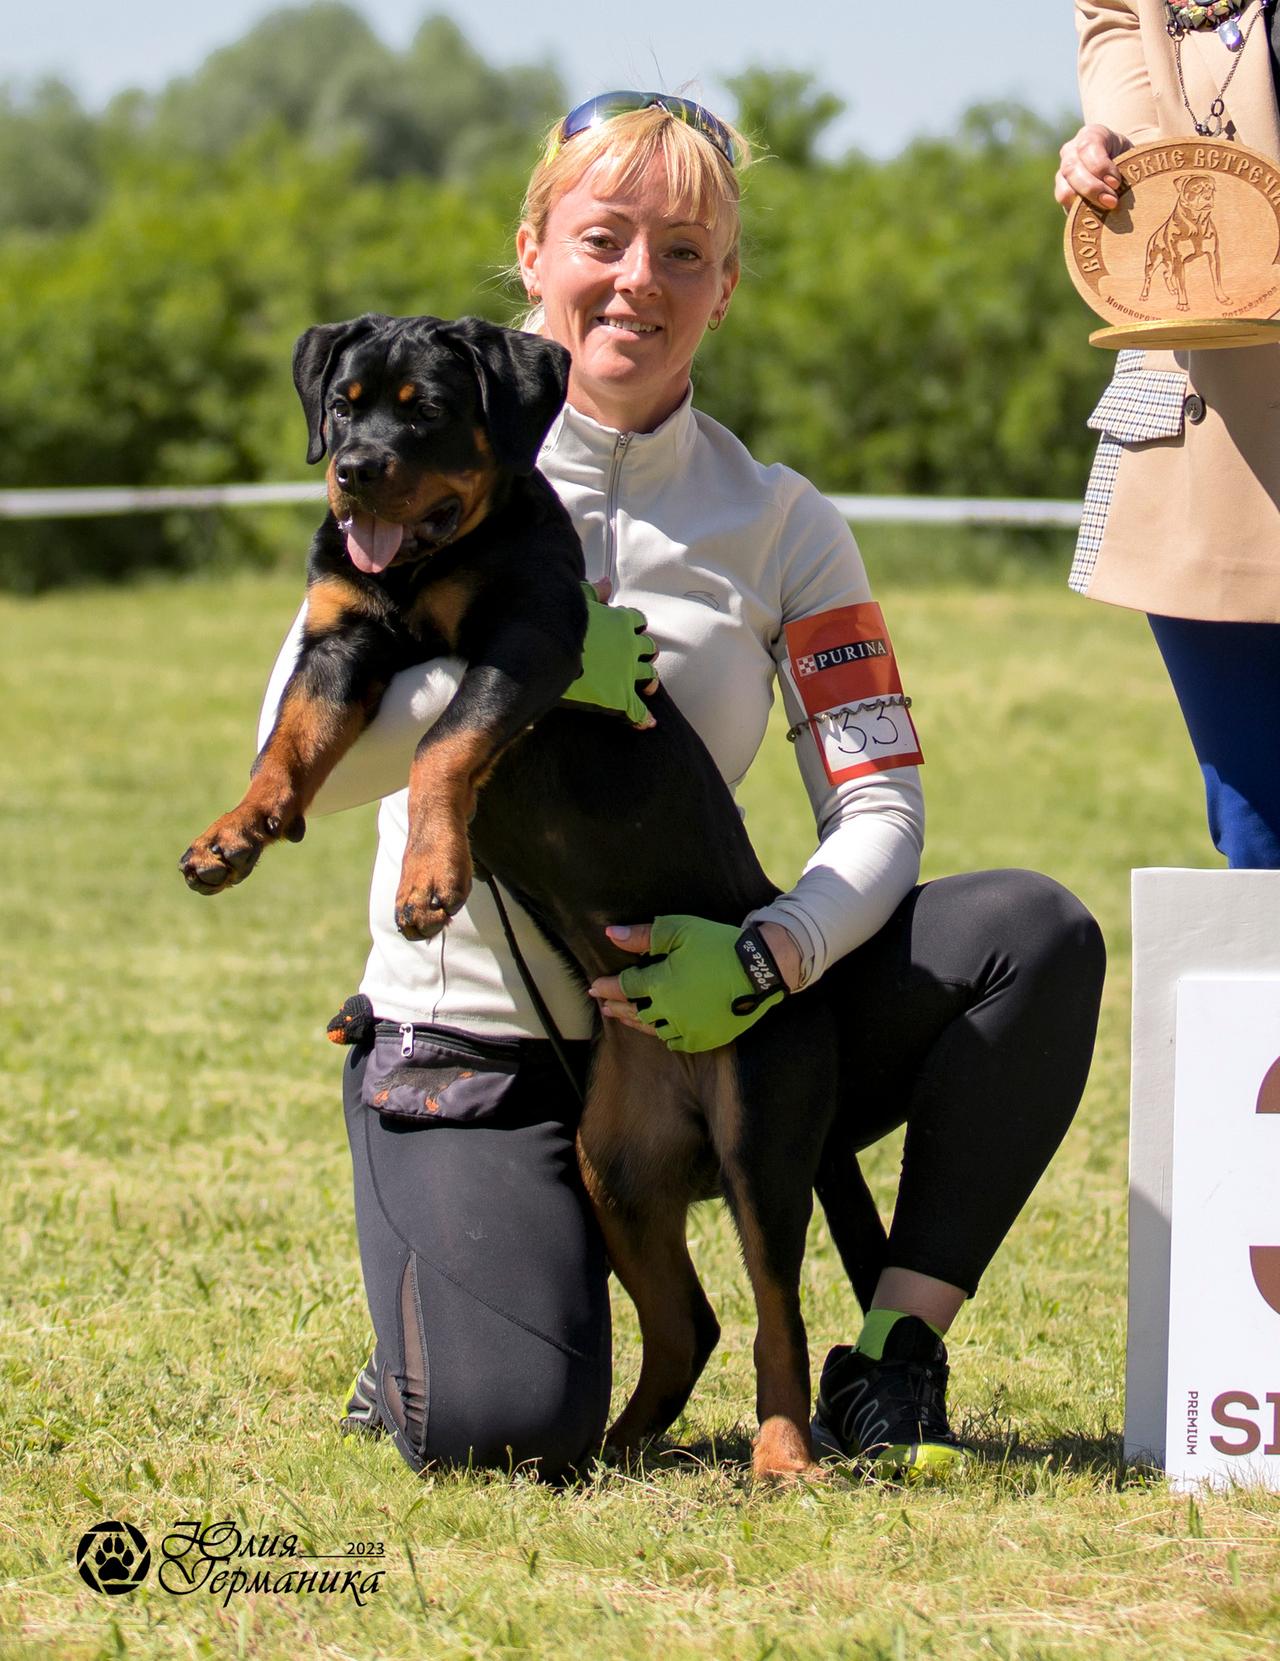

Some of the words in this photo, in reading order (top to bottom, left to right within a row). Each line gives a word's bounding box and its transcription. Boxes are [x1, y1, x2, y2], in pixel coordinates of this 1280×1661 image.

[1079, 148, 1186, 274] ВОРОСКИЕ
[817, 640, 888, 669] PURINA
[752, 951, 775, 979] BIKE
[1186, 1390, 1198, 1456] PREMIUM
